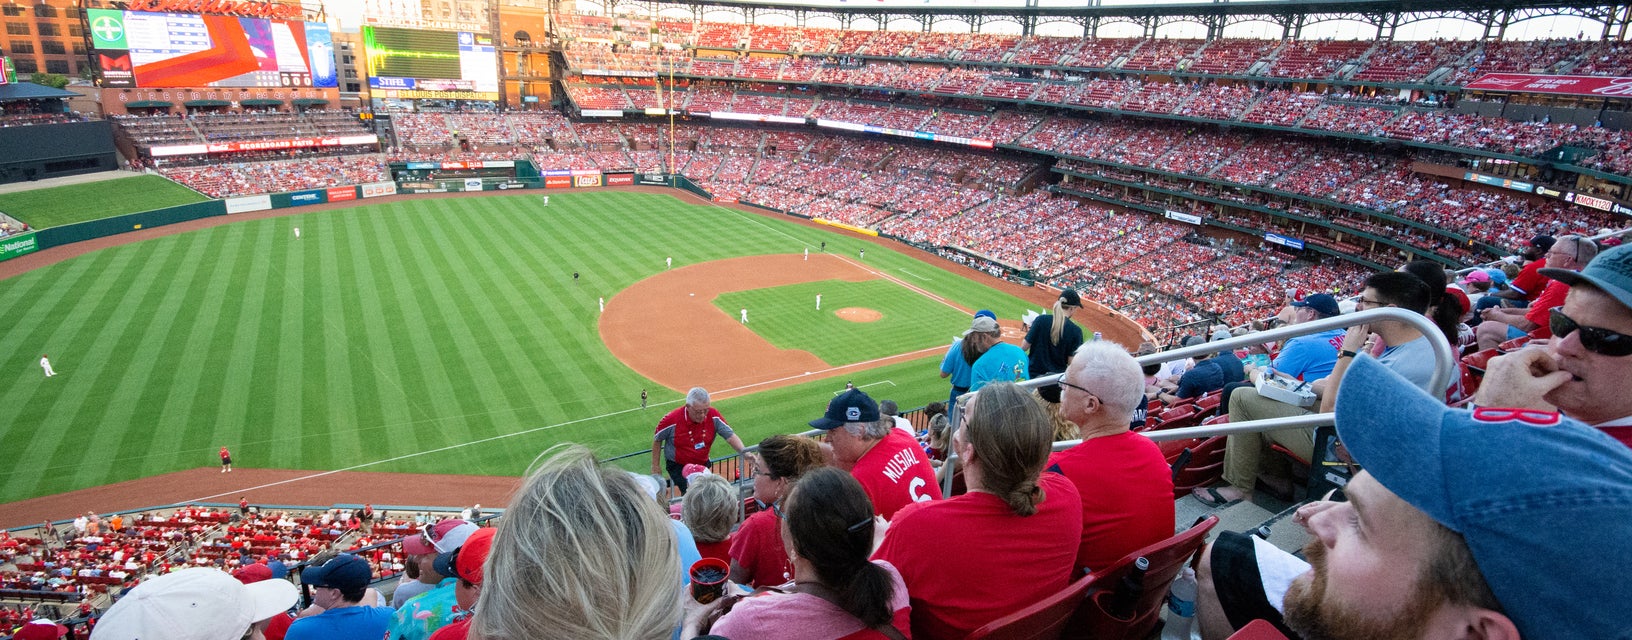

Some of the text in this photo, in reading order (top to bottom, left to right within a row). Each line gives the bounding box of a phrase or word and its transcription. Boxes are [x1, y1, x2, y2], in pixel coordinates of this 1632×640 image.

[421, 20, 481, 31] CHAMPIONS
[378, 77, 406, 86] STIFEL
[413, 90, 433, 99] LOUIS
[239, 140, 290, 149] SCOREBOARD
[292, 139, 314, 147] PATIO
[5, 237, 35, 252] National
[882, 447, 920, 484] MUSIAL
